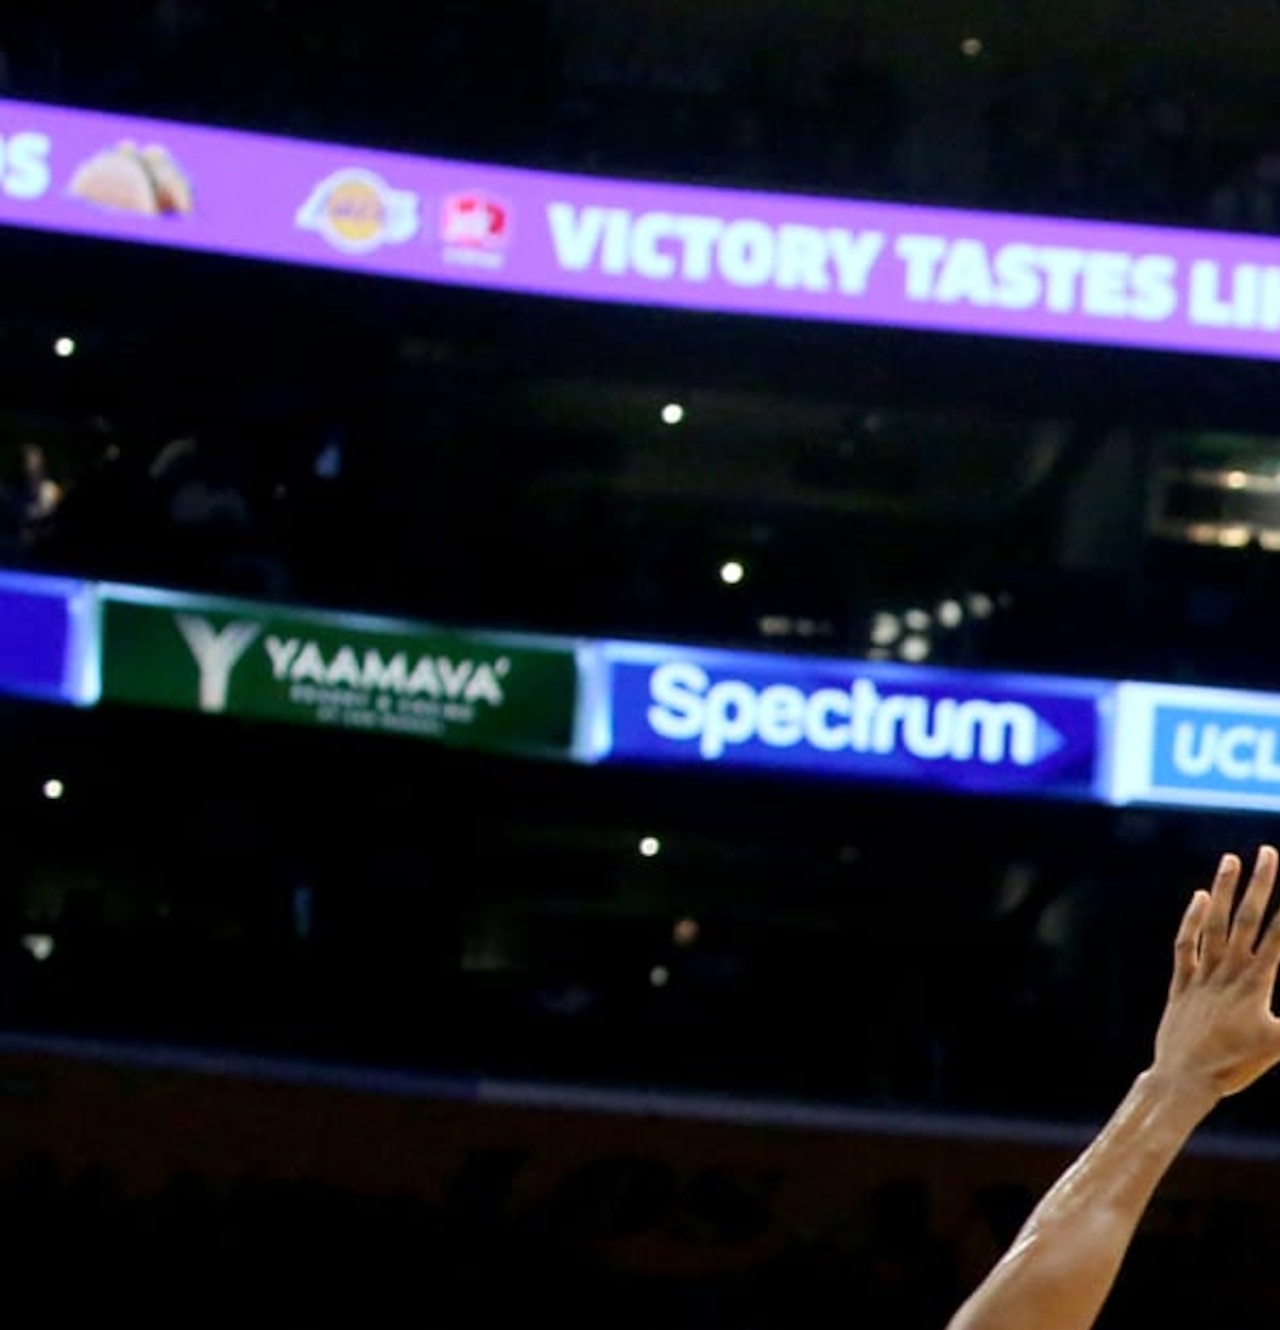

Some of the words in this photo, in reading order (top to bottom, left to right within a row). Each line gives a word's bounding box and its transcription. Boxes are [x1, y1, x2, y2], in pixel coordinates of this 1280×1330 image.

[0, 132, 50, 199] S
[548, 202, 882, 295] VICTORY
[896, 234, 1178, 322] TASTES
[647, 661, 1038, 764] Spectrum
